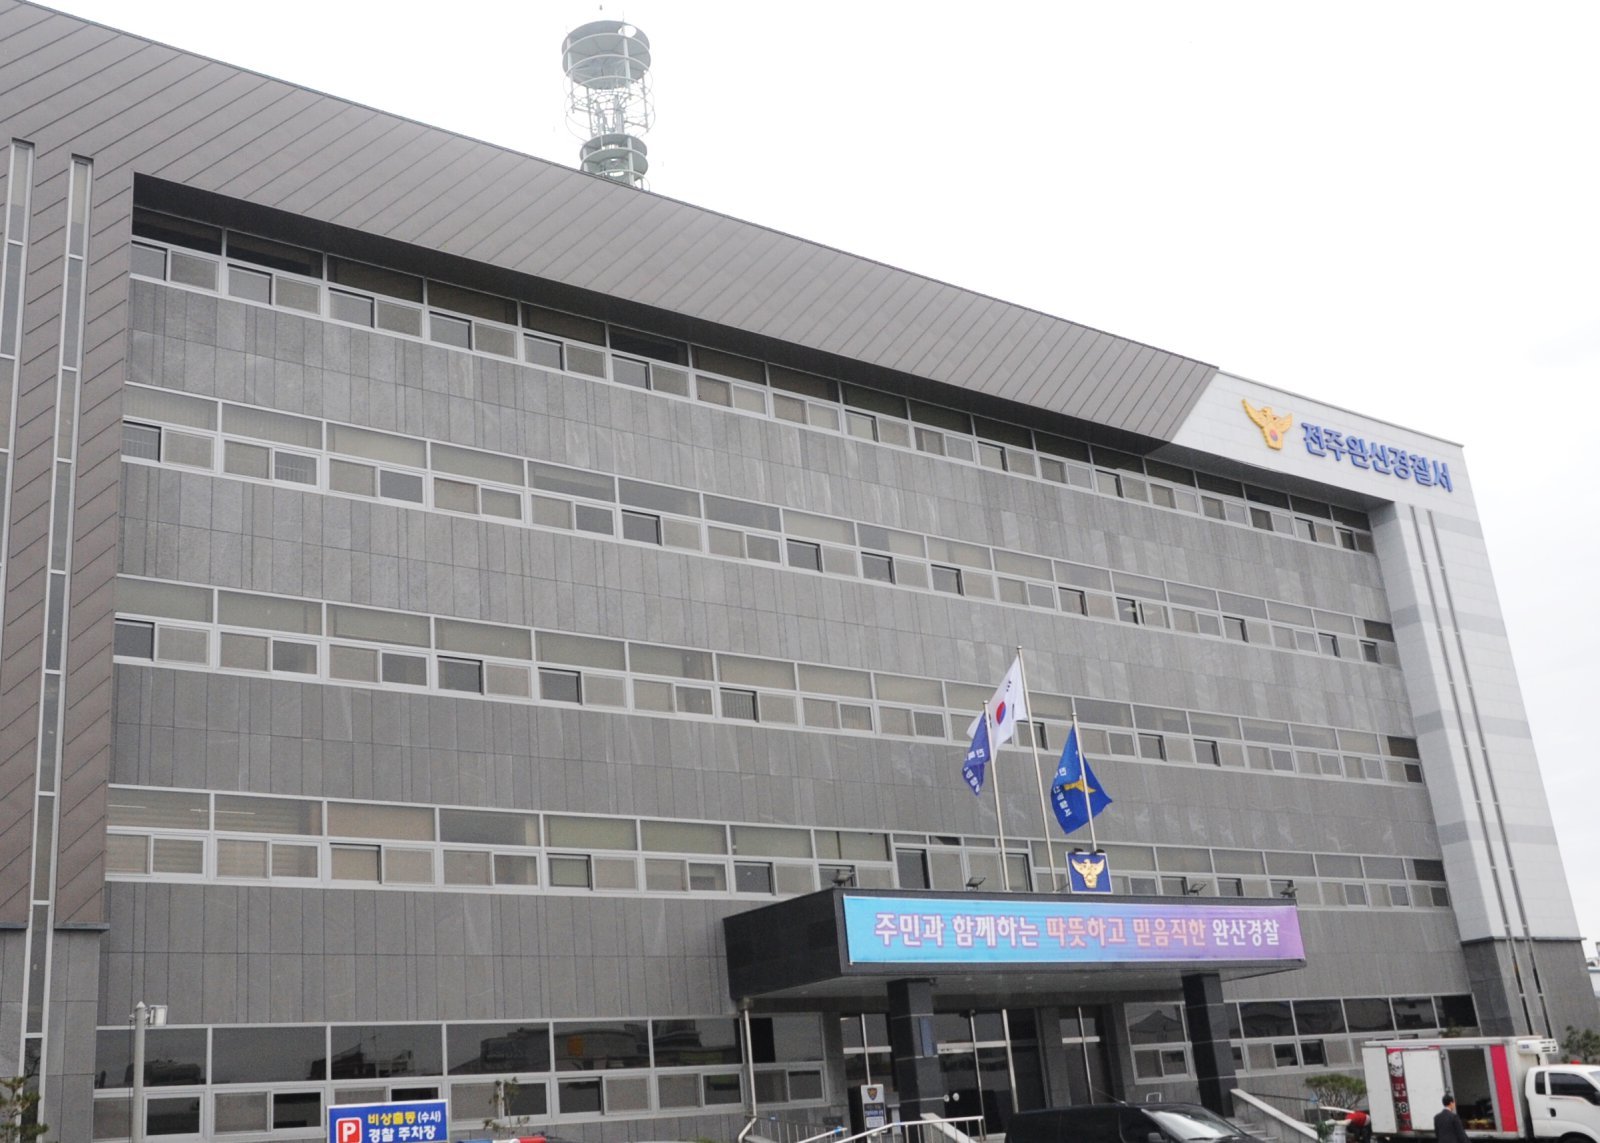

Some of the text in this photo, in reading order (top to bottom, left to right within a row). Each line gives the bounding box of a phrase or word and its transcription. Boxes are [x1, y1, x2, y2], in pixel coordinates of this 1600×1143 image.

[1301, 422, 1453, 492] 전주완산경찰서
[875, 913, 1280, 947] 주민과 함께하는 따뜻하고 믿음직한 완산경찰
[367, 1110, 442, 1126] 비상출동 (수사)
[342, 1122, 357, 1143] P
[368, 1125, 437, 1143] 경찰 주차장
